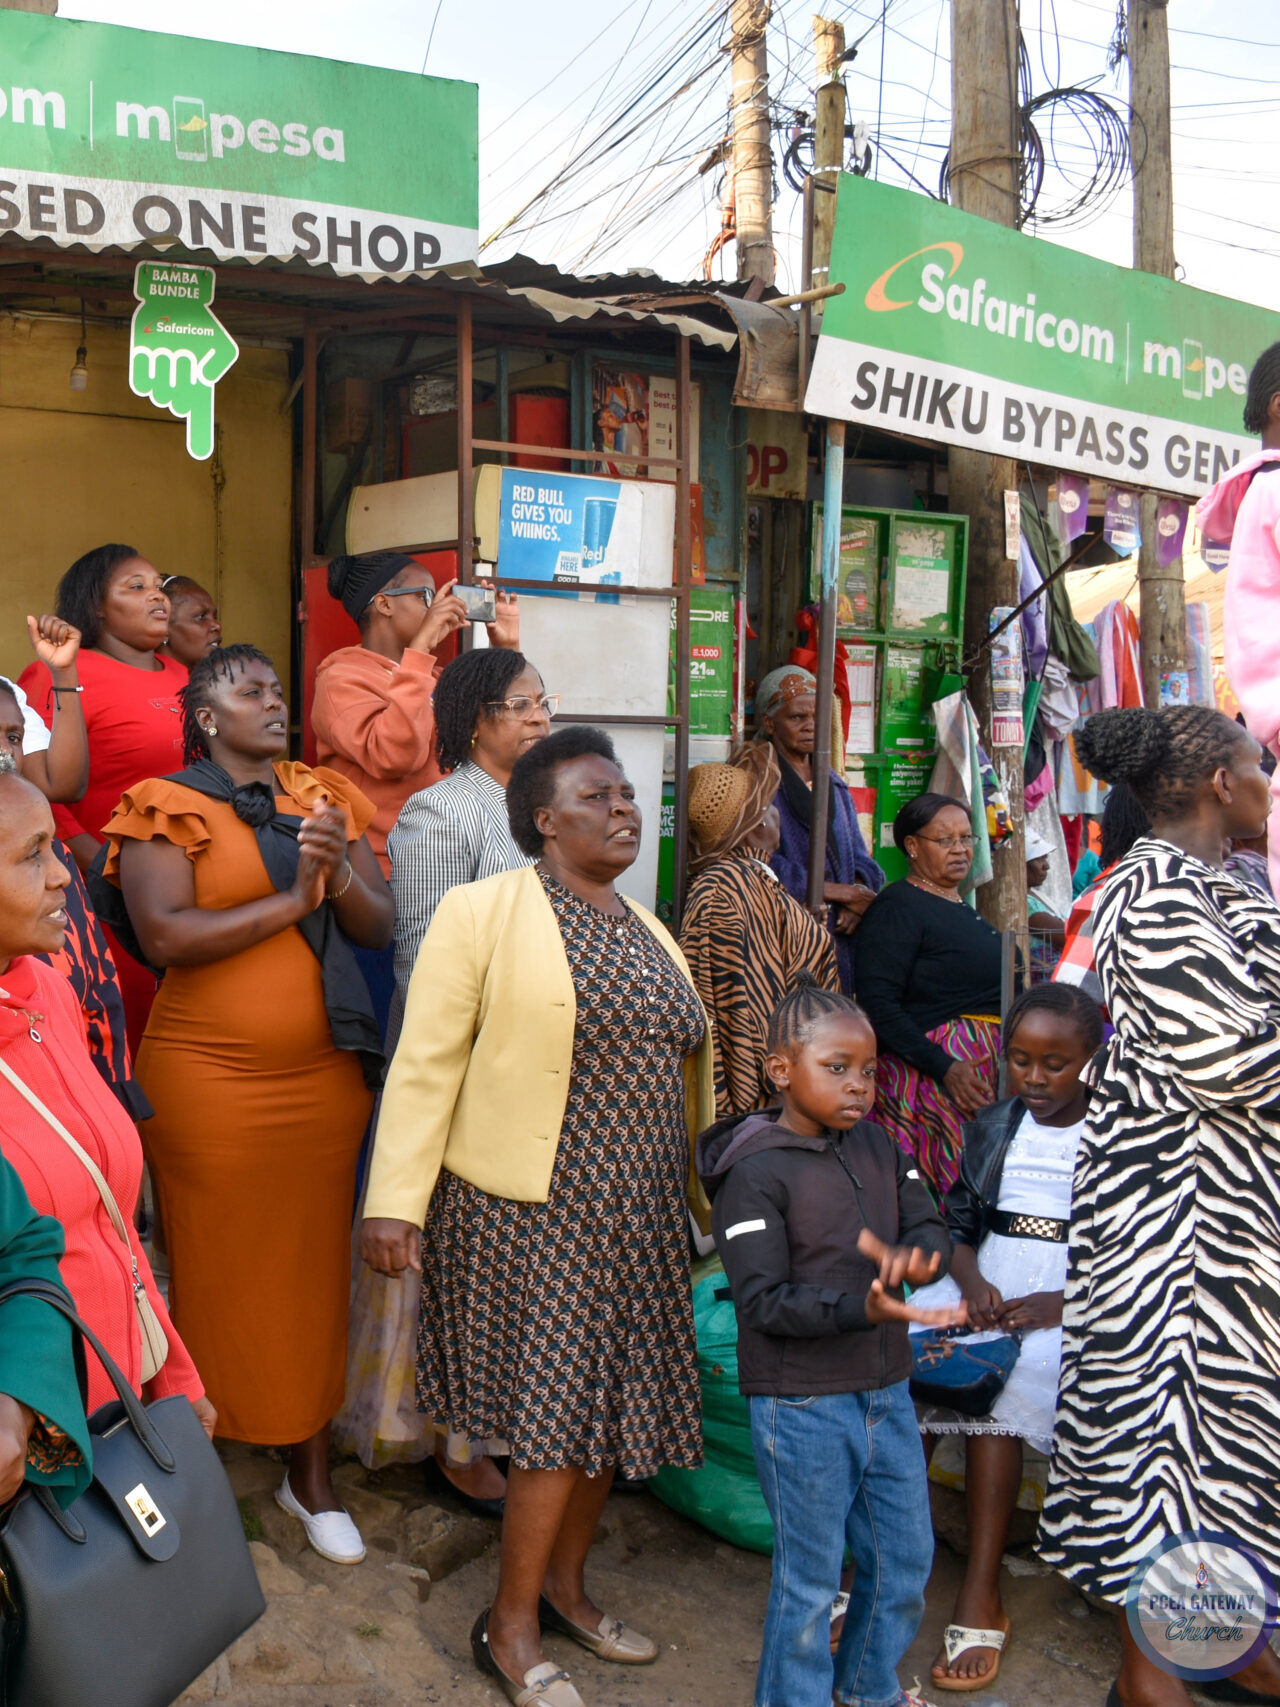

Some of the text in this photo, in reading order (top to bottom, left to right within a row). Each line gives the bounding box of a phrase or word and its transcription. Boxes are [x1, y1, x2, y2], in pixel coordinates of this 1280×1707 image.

[132, 195, 268, 255] ONE
[292, 211, 442, 273] SHOP
[152, 269, 199, 285] BAMBA
[149, 283, 200, 299] BUNDLE
[917, 262, 1114, 364] Safaricom
[156, 321, 215, 337] Safaricom
[850, 361, 989, 436] SHIKU
[1002, 399, 1149, 471] BYPASS
[512, 484, 565, 506] RED BULL
[511, 503, 573, 525] GIVES YOU
[560, 561, 579, 573] HERE
